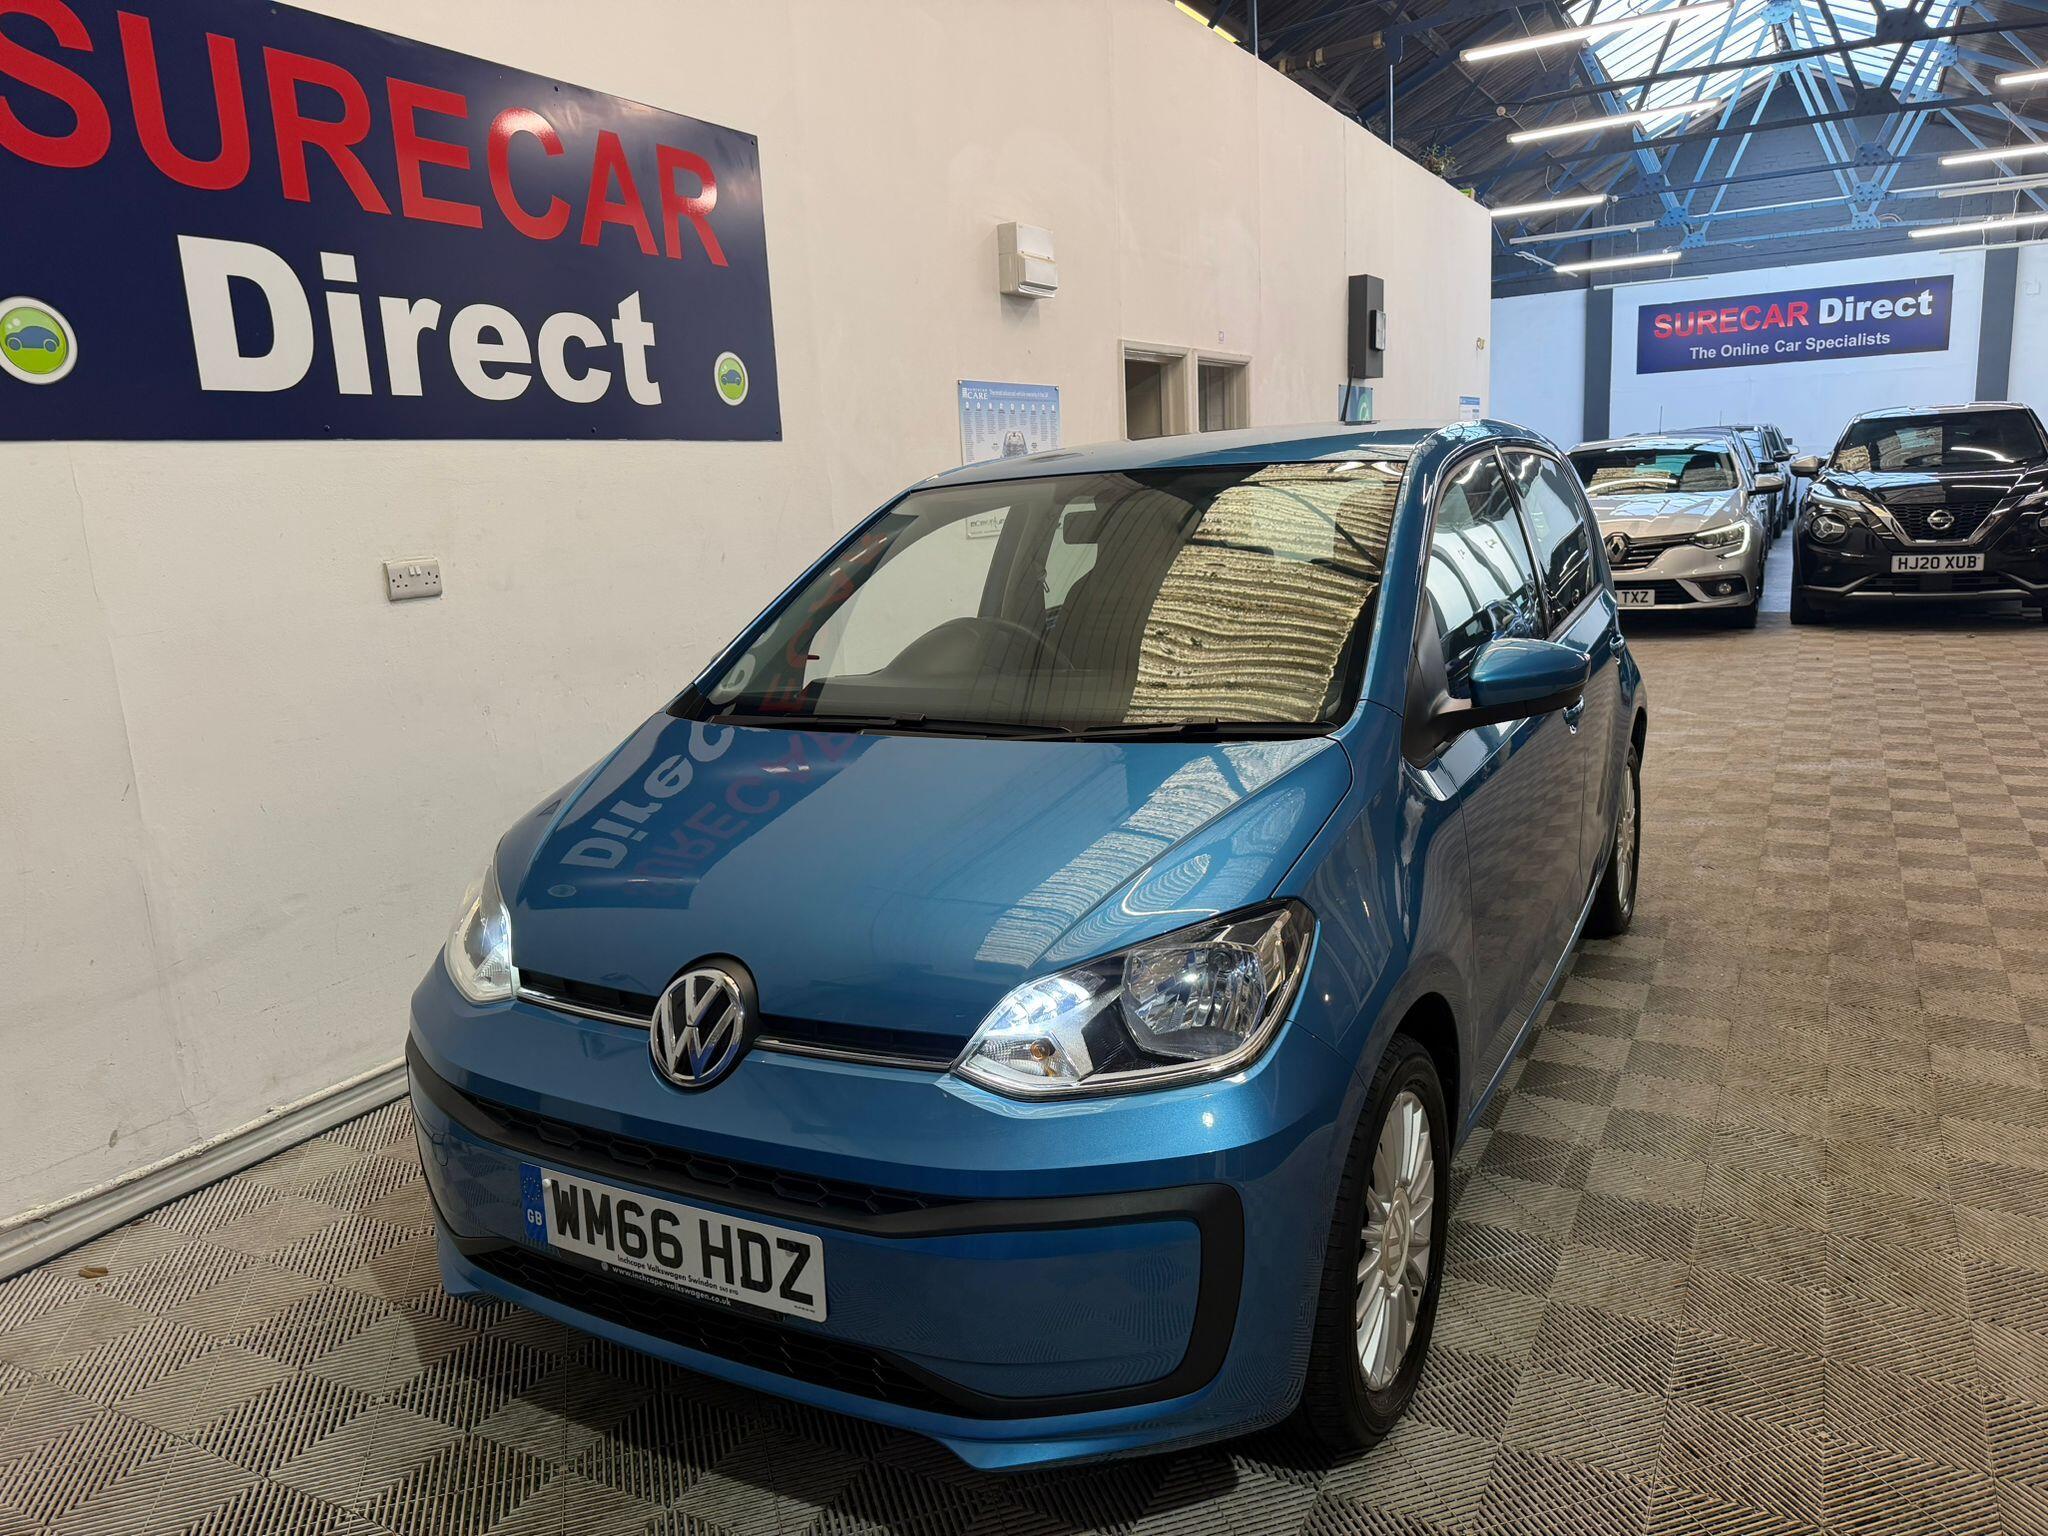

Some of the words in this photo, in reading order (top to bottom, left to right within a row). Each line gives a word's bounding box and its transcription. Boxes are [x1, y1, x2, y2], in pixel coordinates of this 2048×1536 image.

[0, 0, 728, 267] SURECAR
[177, 234, 662, 406] Direct
[1653, 301, 1809, 340] SURECAR
[1818, 288, 1933, 325] Direct
[1689, 346, 1717, 360] The
[1720, 341, 1770, 357] Online
[1774, 338, 1801, 353] Car
[1805, 331, 1891, 353] Specialists
[967, 391, 988, 400] CARE
[1897, 556, 1940, 570] HJ20
[1944, 555, 1978, 569] XUB
[1621, 590, 1649, 604] TXZ
[526, 1208, 543, 1226] GB
[550, 1178, 683, 1269] WM66
[699, 1218, 814, 1307] HDZ
[617, 1253, 646, 1270] Inchcape
[646, 1262, 687, 1281] Volkswagen
[688, 1274, 718, 1290] Swindon
